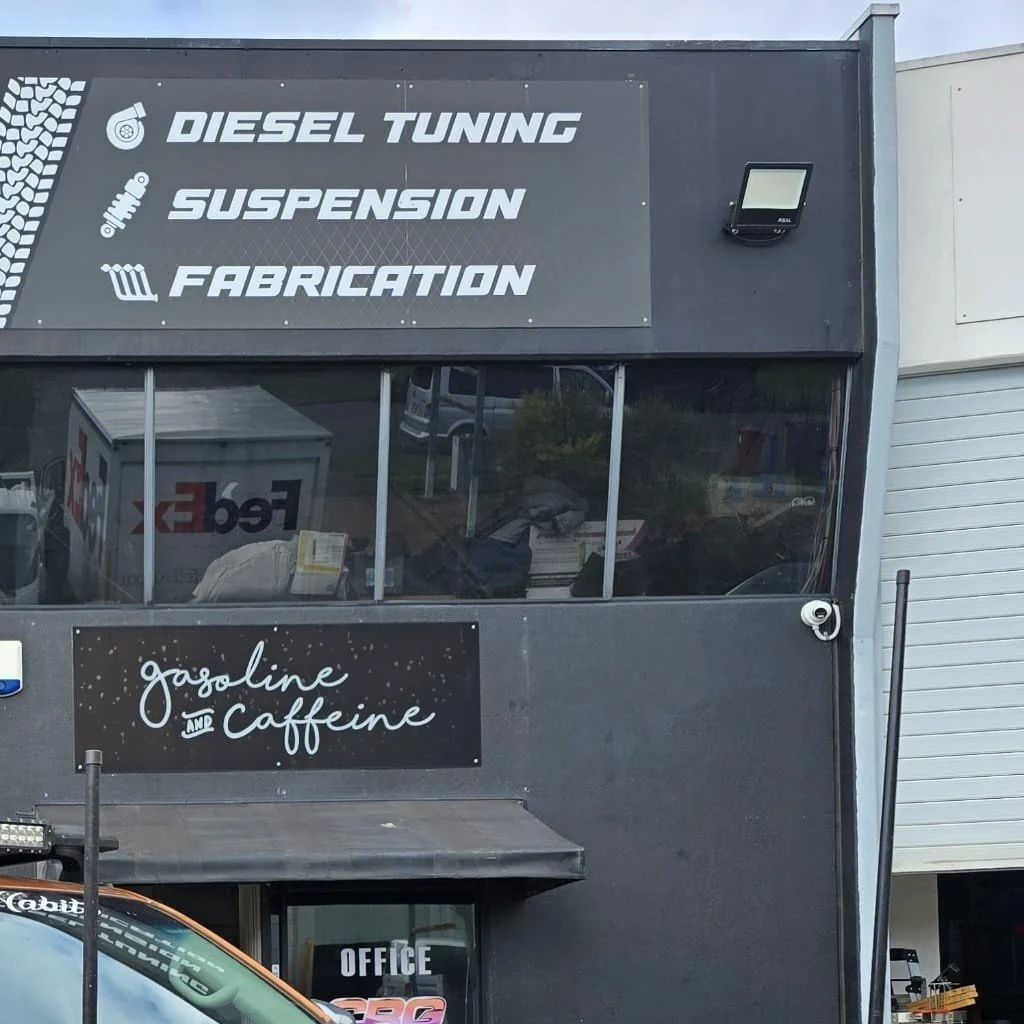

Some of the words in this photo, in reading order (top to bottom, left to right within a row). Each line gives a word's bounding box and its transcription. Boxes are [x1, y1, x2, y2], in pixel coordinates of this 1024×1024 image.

[166, 111, 365, 143] DIESEL
[384, 112, 582, 143] TUNING
[167, 188, 527, 220] SUSPENSION
[168, 264, 537, 297] FABRICATION
[139, 641, 349, 729] gasoline
[183, 711, 214, 736] AND
[340, 946, 432, 977] OFFICE
